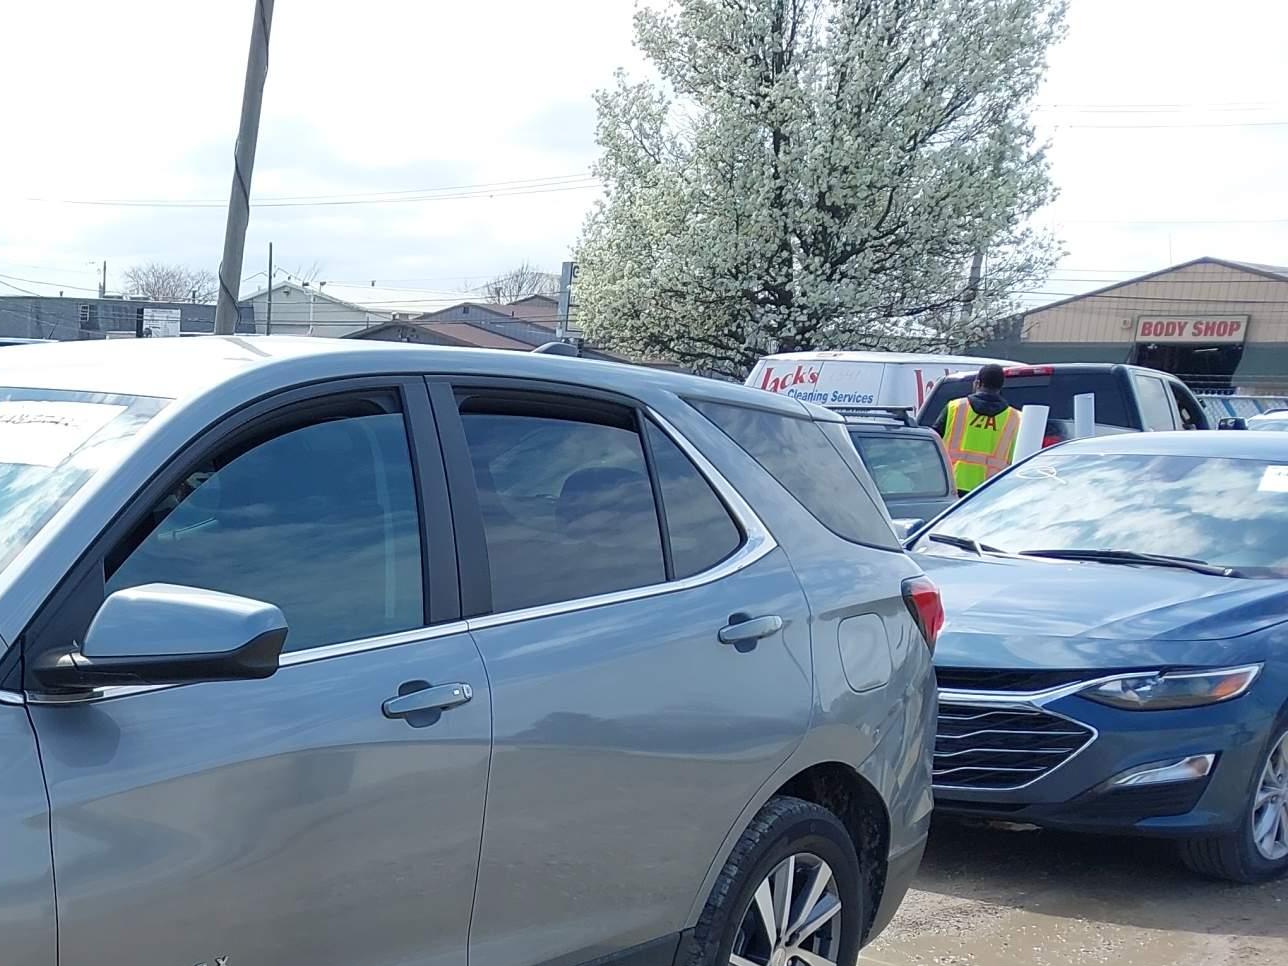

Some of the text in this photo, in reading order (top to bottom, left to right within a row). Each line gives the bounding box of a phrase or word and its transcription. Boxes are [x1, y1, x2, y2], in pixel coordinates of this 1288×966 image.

[1140, 320, 1242, 337] BODY SHOP
[761, 364, 820, 393] Jack's
[787, 388, 874, 405] Cleaning Services
